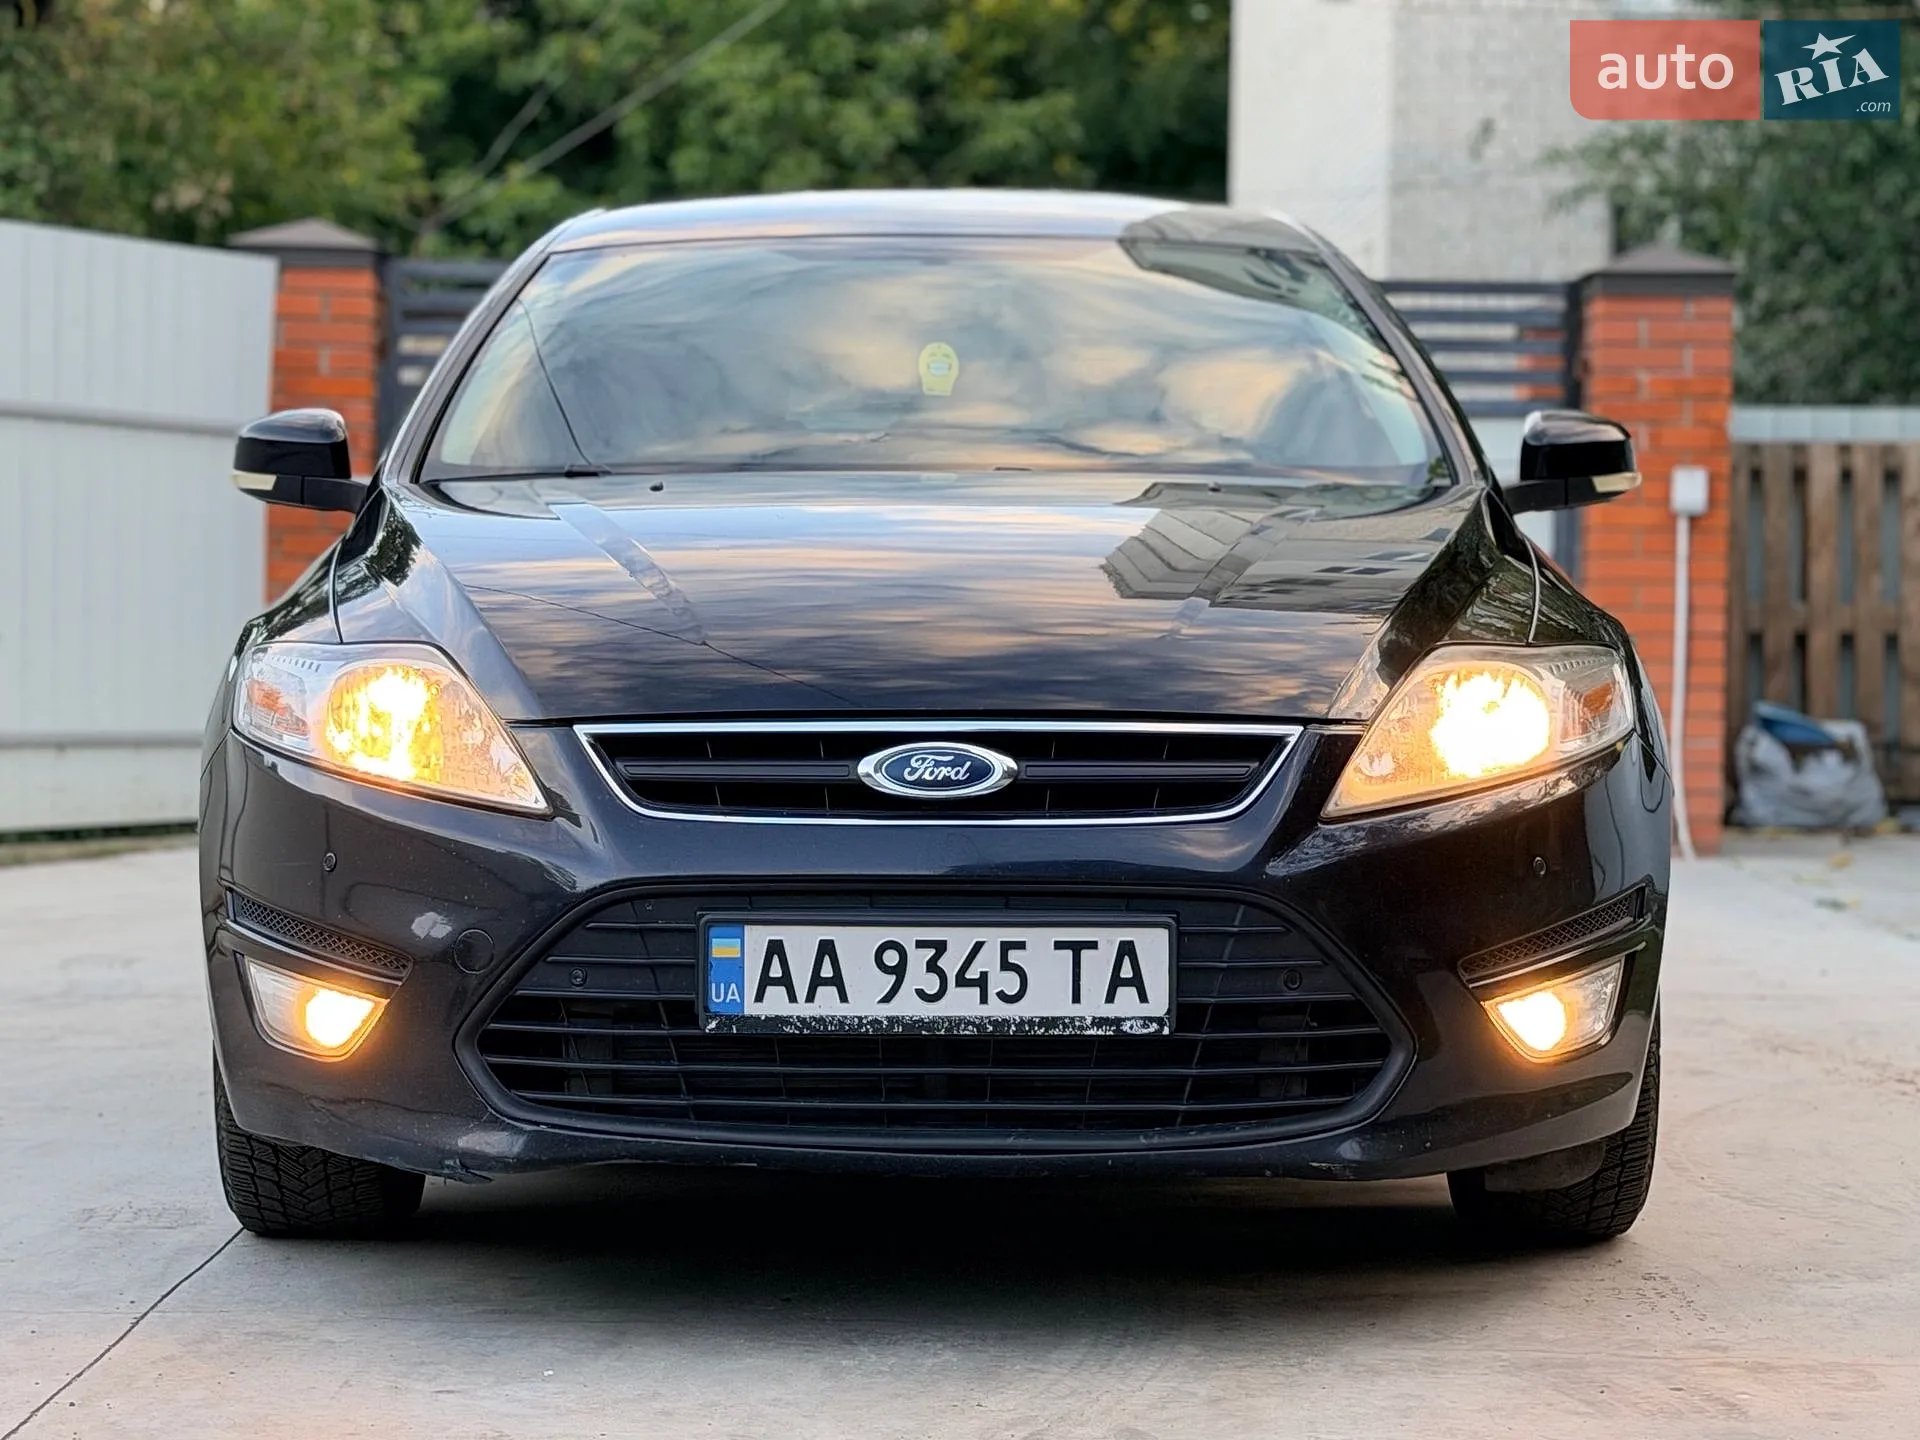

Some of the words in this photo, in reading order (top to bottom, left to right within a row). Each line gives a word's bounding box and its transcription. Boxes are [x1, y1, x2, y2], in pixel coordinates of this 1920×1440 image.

[903, 754, 971, 781] Ford
[753, 938, 849, 1004] AA
[873, 938, 1029, 1004] 9345
[1053, 939, 1150, 1004] TA
[711, 982, 741, 1003] UA
